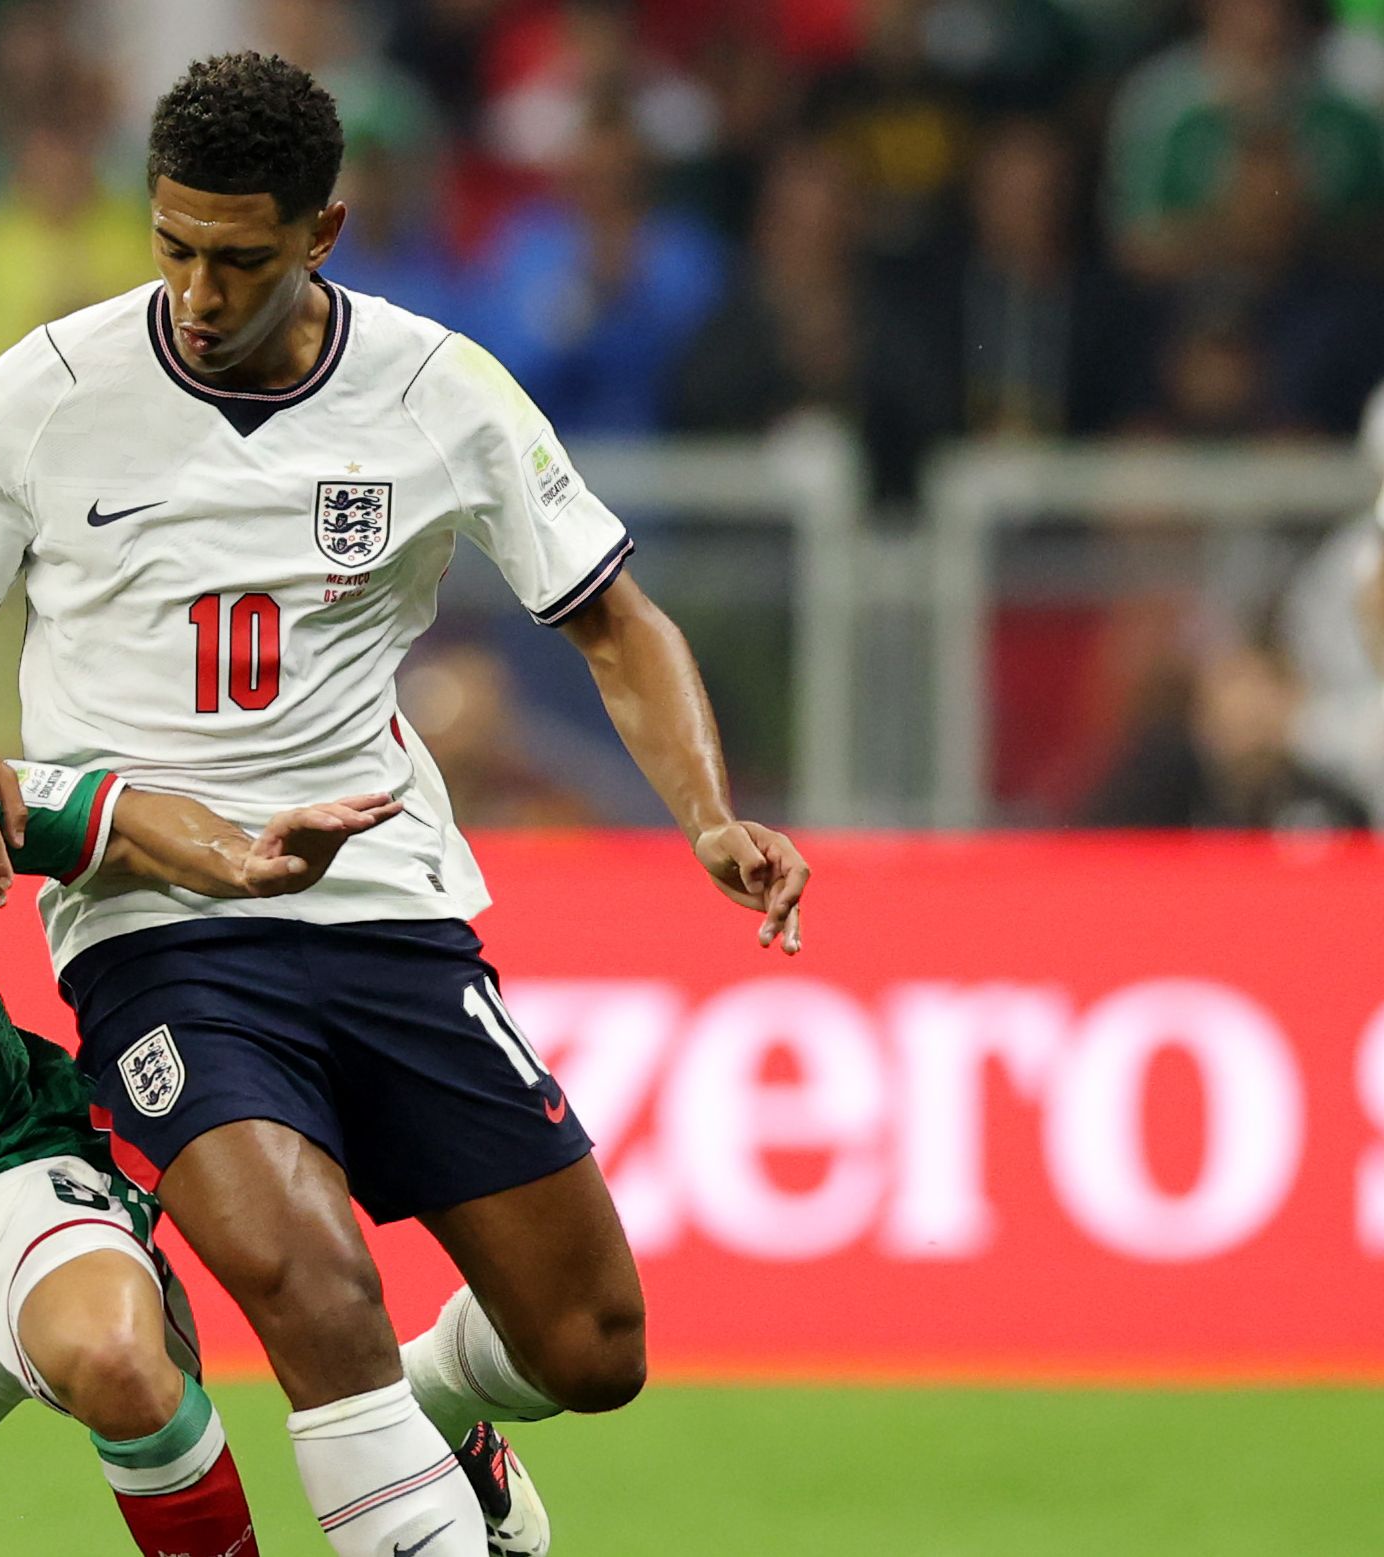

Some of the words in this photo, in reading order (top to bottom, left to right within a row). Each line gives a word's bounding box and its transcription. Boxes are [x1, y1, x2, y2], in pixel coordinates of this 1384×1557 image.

[326, 571, 370, 586] MEXICO
[189, 592, 281, 713] 10
[499, 974, 1308, 1264] zero
